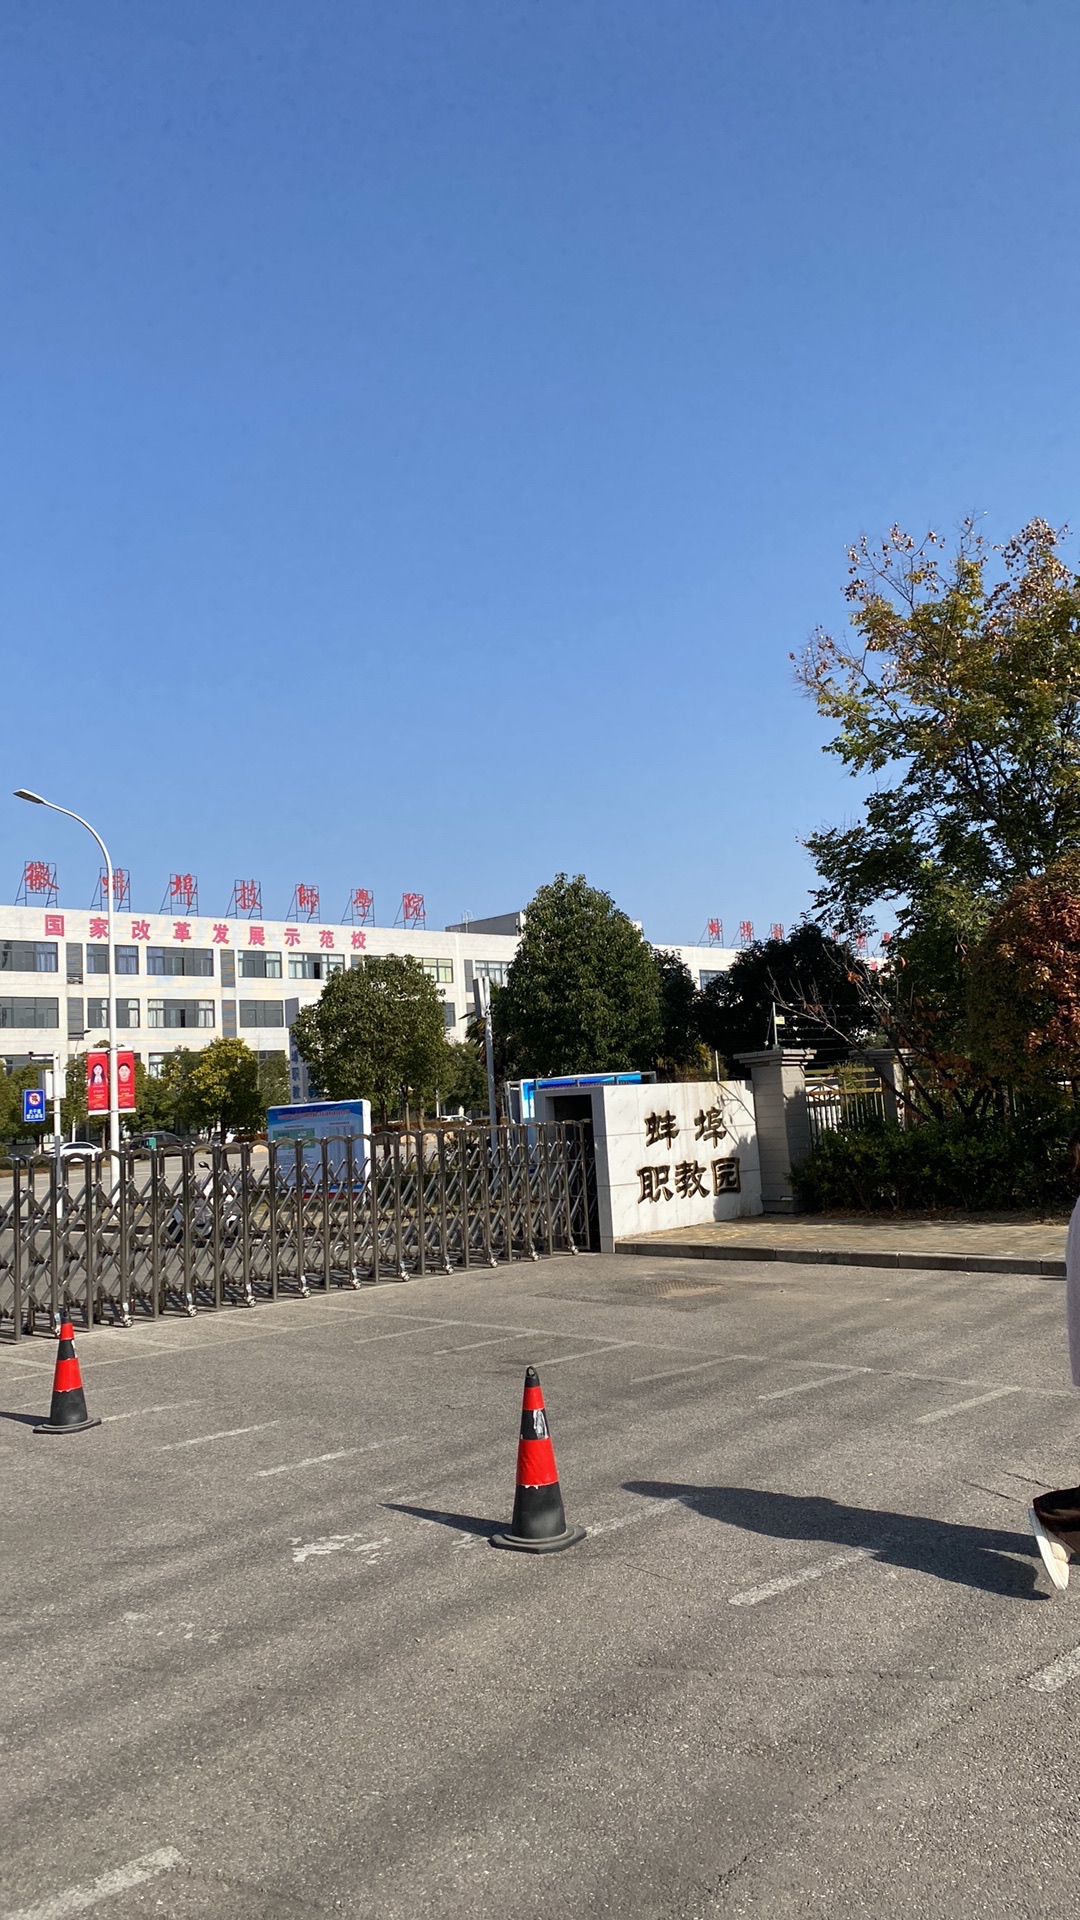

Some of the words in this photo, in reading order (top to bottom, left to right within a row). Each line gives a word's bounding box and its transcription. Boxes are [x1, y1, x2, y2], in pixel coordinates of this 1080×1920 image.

[44, 914, 367, 950] 国家改革发展示范校
[645, 1106, 728, 1150] 蚌埠
[637, 1156, 742, 1204] 职教园
